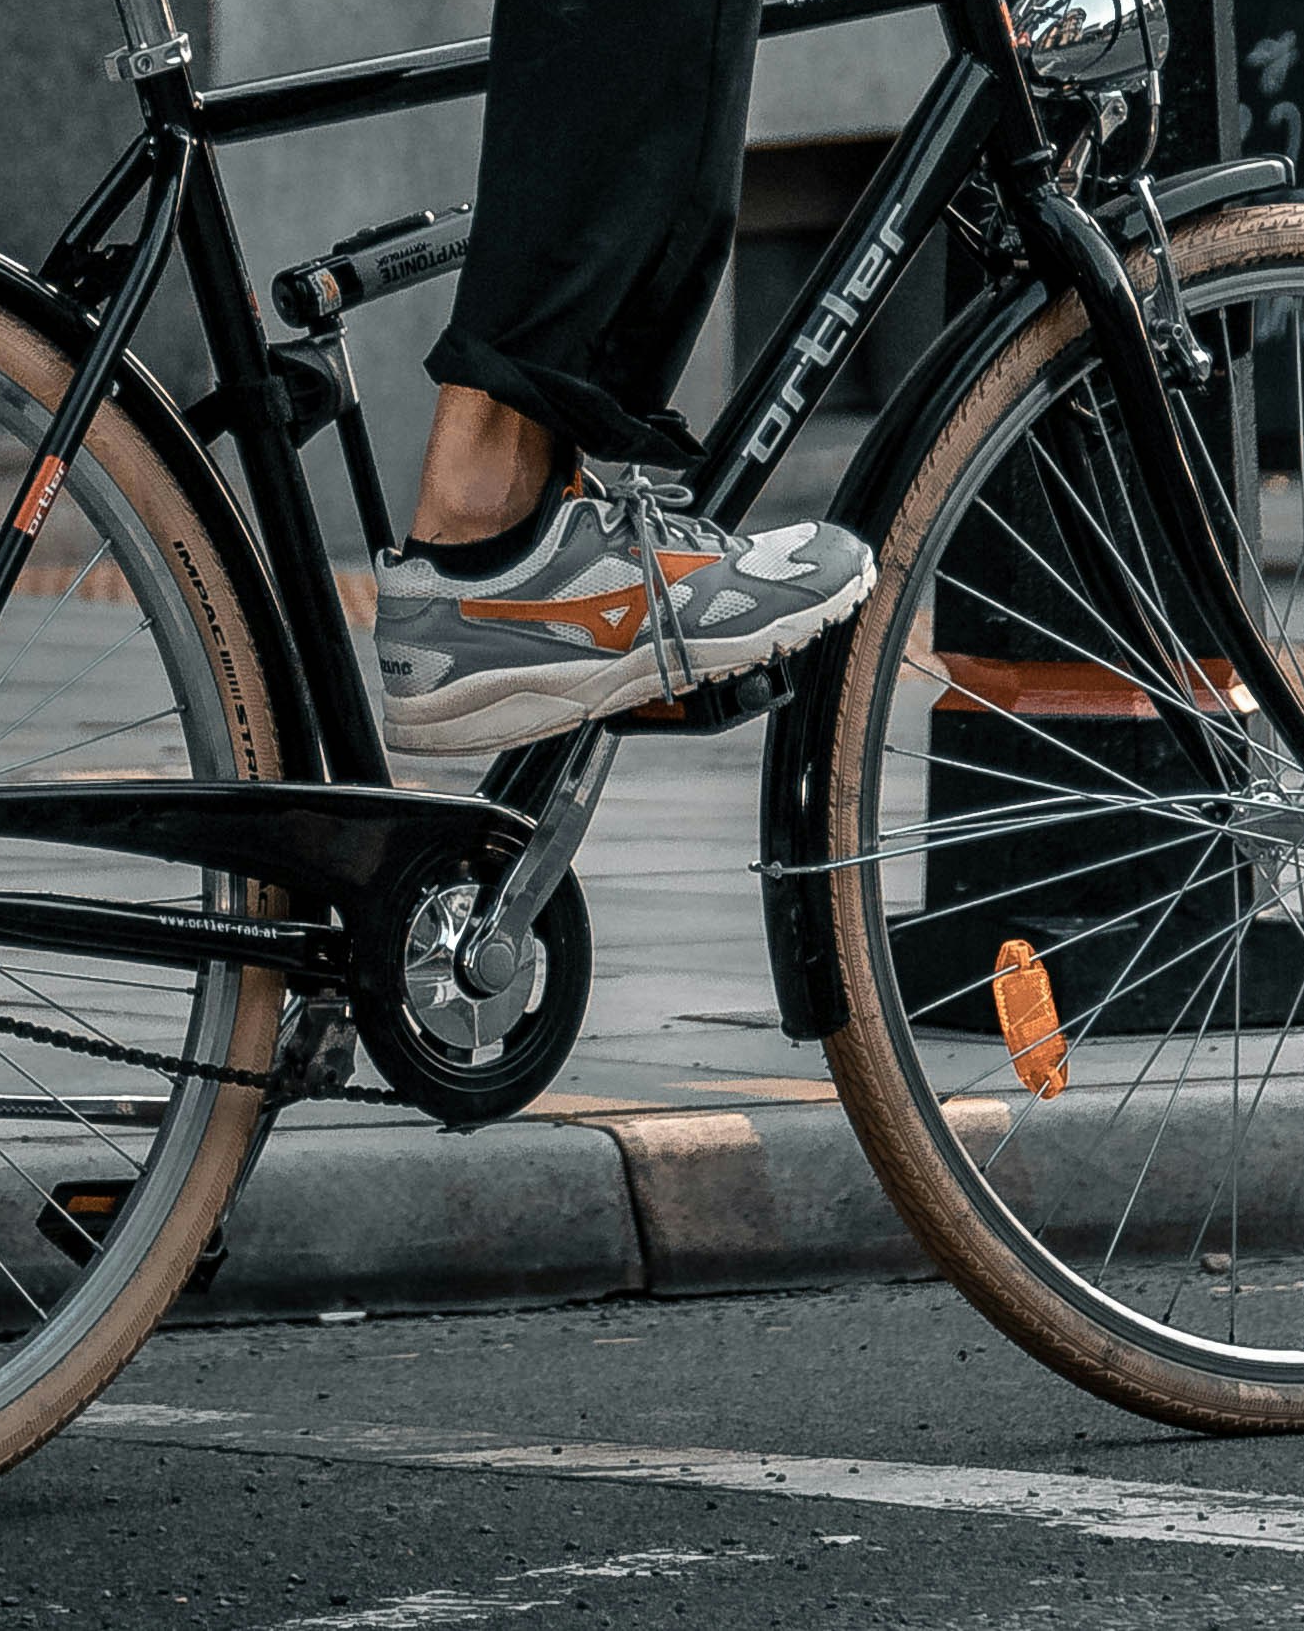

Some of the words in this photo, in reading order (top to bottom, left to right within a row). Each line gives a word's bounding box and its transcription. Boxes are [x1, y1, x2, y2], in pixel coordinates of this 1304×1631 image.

[379, 237, 470, 285] RYPTONITE
[741, 203, 908, 465] ortler
[26, 461, 65, 537] ortler
[172, 540, 226, 647] IMPAC
[159, 914, 277, 940] www.ortler-rad.at
